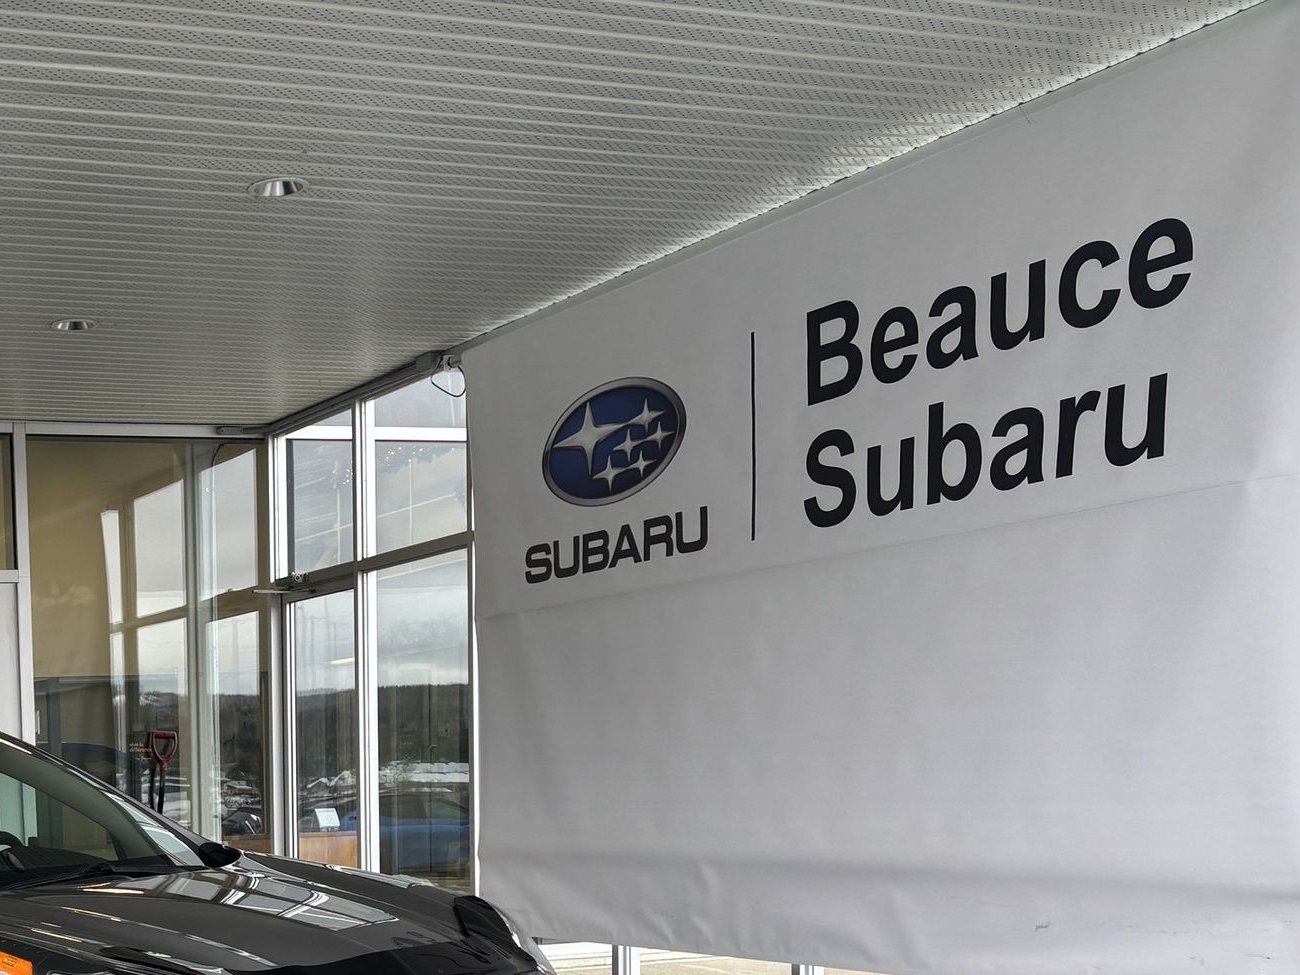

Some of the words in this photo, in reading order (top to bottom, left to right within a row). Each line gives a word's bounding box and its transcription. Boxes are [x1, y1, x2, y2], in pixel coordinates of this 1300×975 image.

[807, 218, 1194, 406] Beauce
[803, 373, 1168, 528] Subaru
[525, 505, 709, 584] SUBARU
